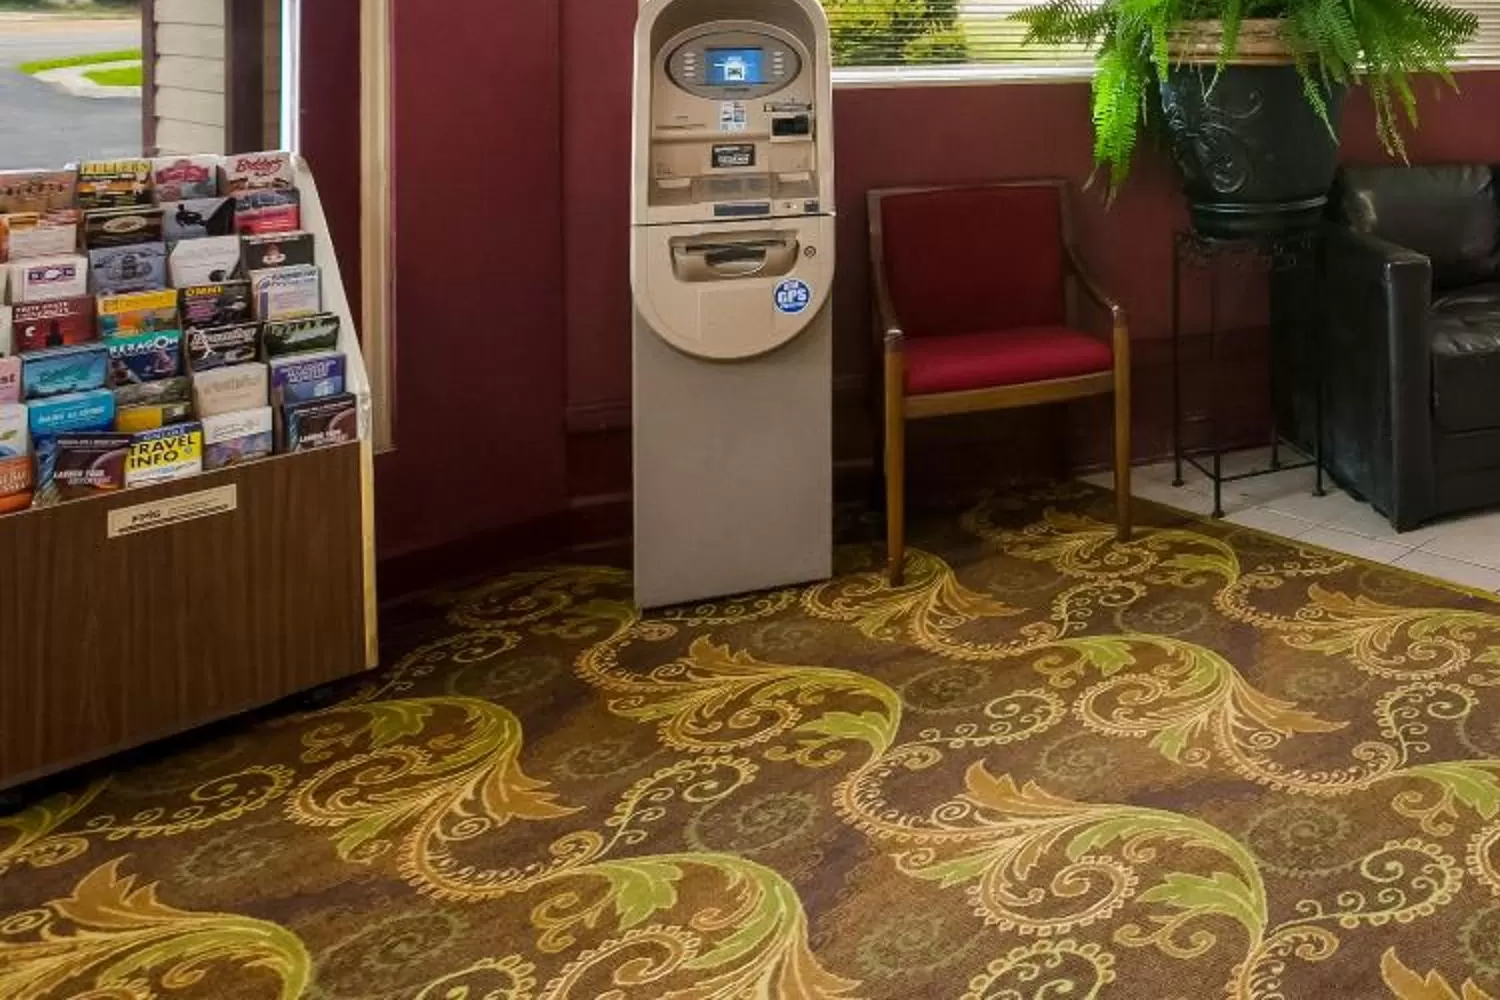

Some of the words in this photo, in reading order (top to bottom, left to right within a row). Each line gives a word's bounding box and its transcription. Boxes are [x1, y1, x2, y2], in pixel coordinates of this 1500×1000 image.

[777, 289, 806, 304] GPS
[130, 433, 196, 456] TRAVEL
[130, 450, 178, 469] INFO
